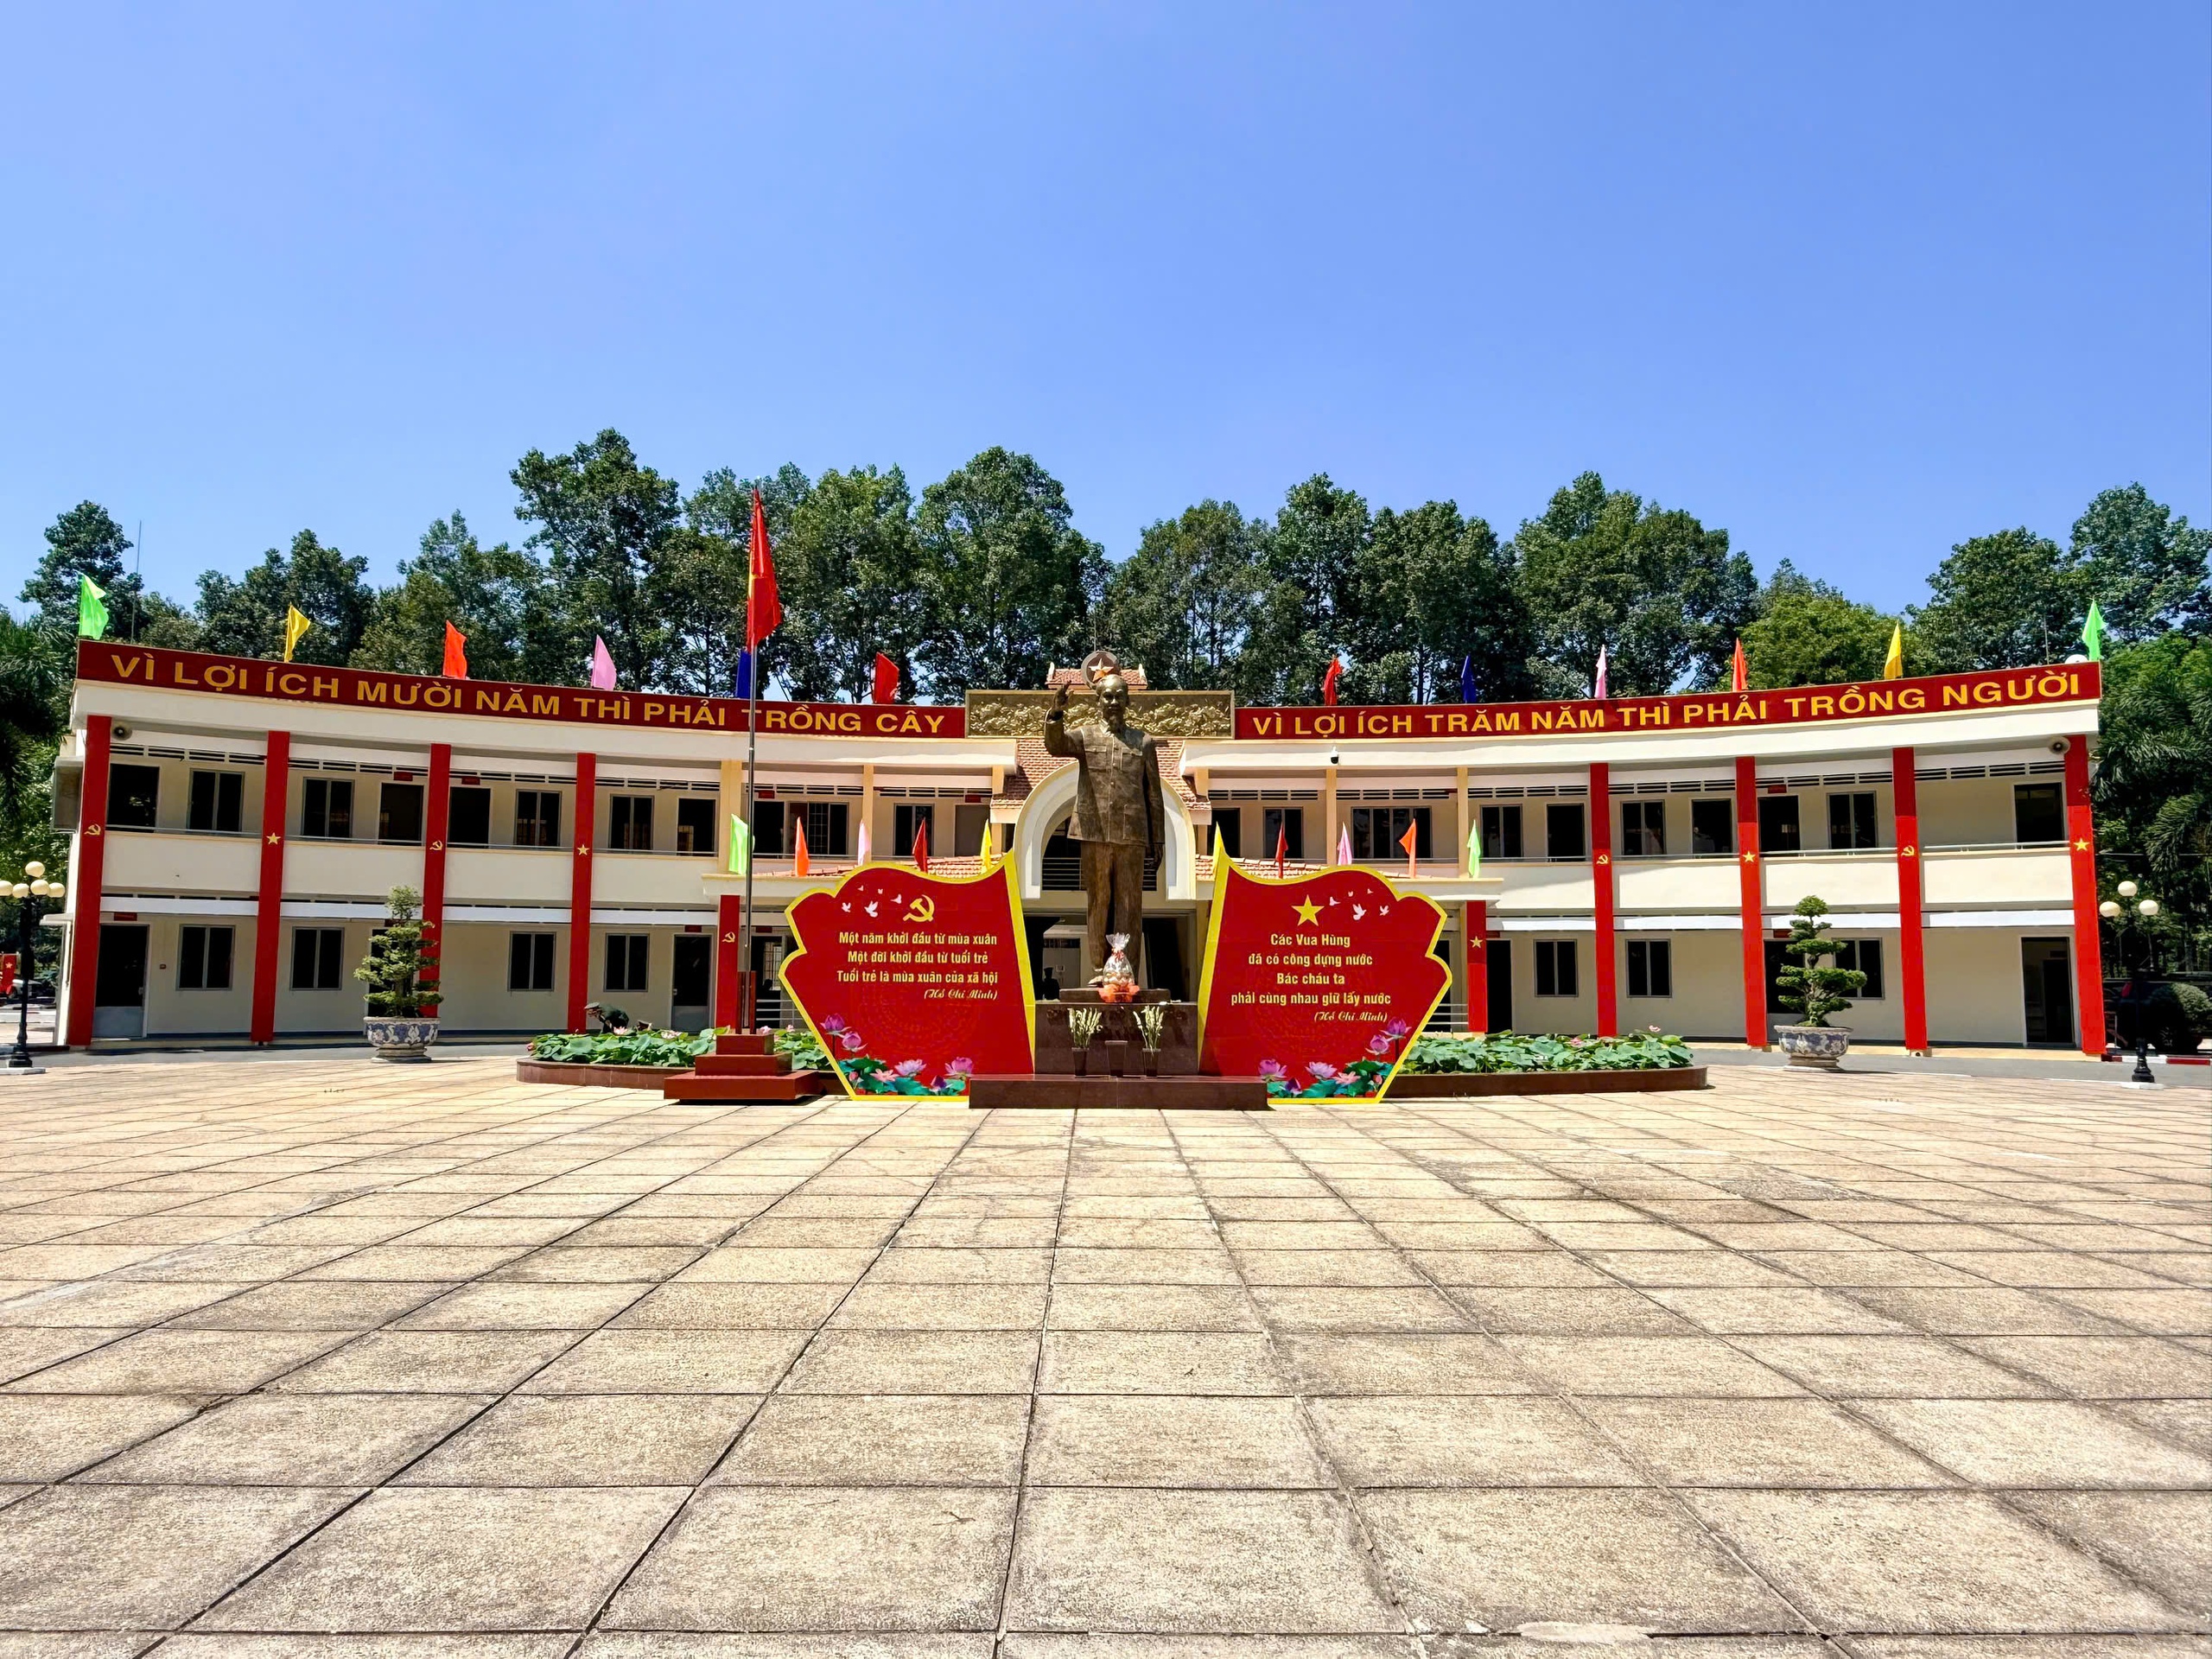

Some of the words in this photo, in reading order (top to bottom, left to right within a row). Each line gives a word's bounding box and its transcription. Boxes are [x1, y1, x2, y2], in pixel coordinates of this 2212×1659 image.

[111, 653, 155, 680] VÌ
[175, 662, 247, 692] LỢI
[265, 666, 339, 698] ÍCH
[357, 680, 461, 708] MƯỜI
[476, 688, 560, 715] NĂM
[574, 696, 630, 720] THÌ
[644, 699, 725, 726] PHẢI
[741, 703, 861, 732] TRỒNG
[875, 709, 944, 734] CÂY
[1252, 711, 1282, 735] VÌ
[1294, 713, 1345, 739] LỢI
[1357, 710, 1412, 734] ÍCH
[1425, 707, 1520, 733] TRĂM
[1531, 705, 1605, 730] NĂM
[1616, 700, 1670, 727] THÌ
[1683, 694, 1767, 724] PHẢI
[1783, 684, 1925, 717] TRỒNG
[1942, 669, 2079, 707] NGƯỜI
[839, 931, 860, 946] Một
[861, 932, 884, 945] năm
[934, 932, 946, 944] từ
[948, 932, 970, 945] mùa
[972, 932, 997, 945] xuân
[1270, 933, 1293, 946] Các
[1295, 933, 1318, 946] Vua
[1321, 933, 1351, 948] Hùng
[847, 950, 868, 965] Một
[870, 950, 887, 963] đời
[937, 950, 949, 963] từ
[973, 950, 988, 964] trẻ
[1248, 952, 1262, 966] đã
[1266, 952, 1280, 966] có
[1282, 953, 1311, 968] công
[1313, 953, 1342, 968] dựng
[1345, 953, 1373, 966] nước
[836, 967, 859, 982] Tuổi
[861, 969, 877, 982] trẻ
[880, 970, 890, 982] là
[892, 970, 914, 982] mùa
[917, 970, 943, 983] xuân
[944, 970, 964, 983] của
[967, 971, 980, 984] xã
[982, 971, 998, 986] hội
[1276, 972, 1299, 985] Bác
[1301, 972, 1330, 985] cháu
[1332, 973, 1345, 985] ta
[1230, 990, 1255, 1006] phải
[1259, 991, 1287, 1007] cùng
[1290, 992, 1319, 1005] nhau
[1322, 992, 1340, 1007] giữ
[1343, 990, 1360, 1007] lấy
[1363, 992, 1391, 1005] nước
